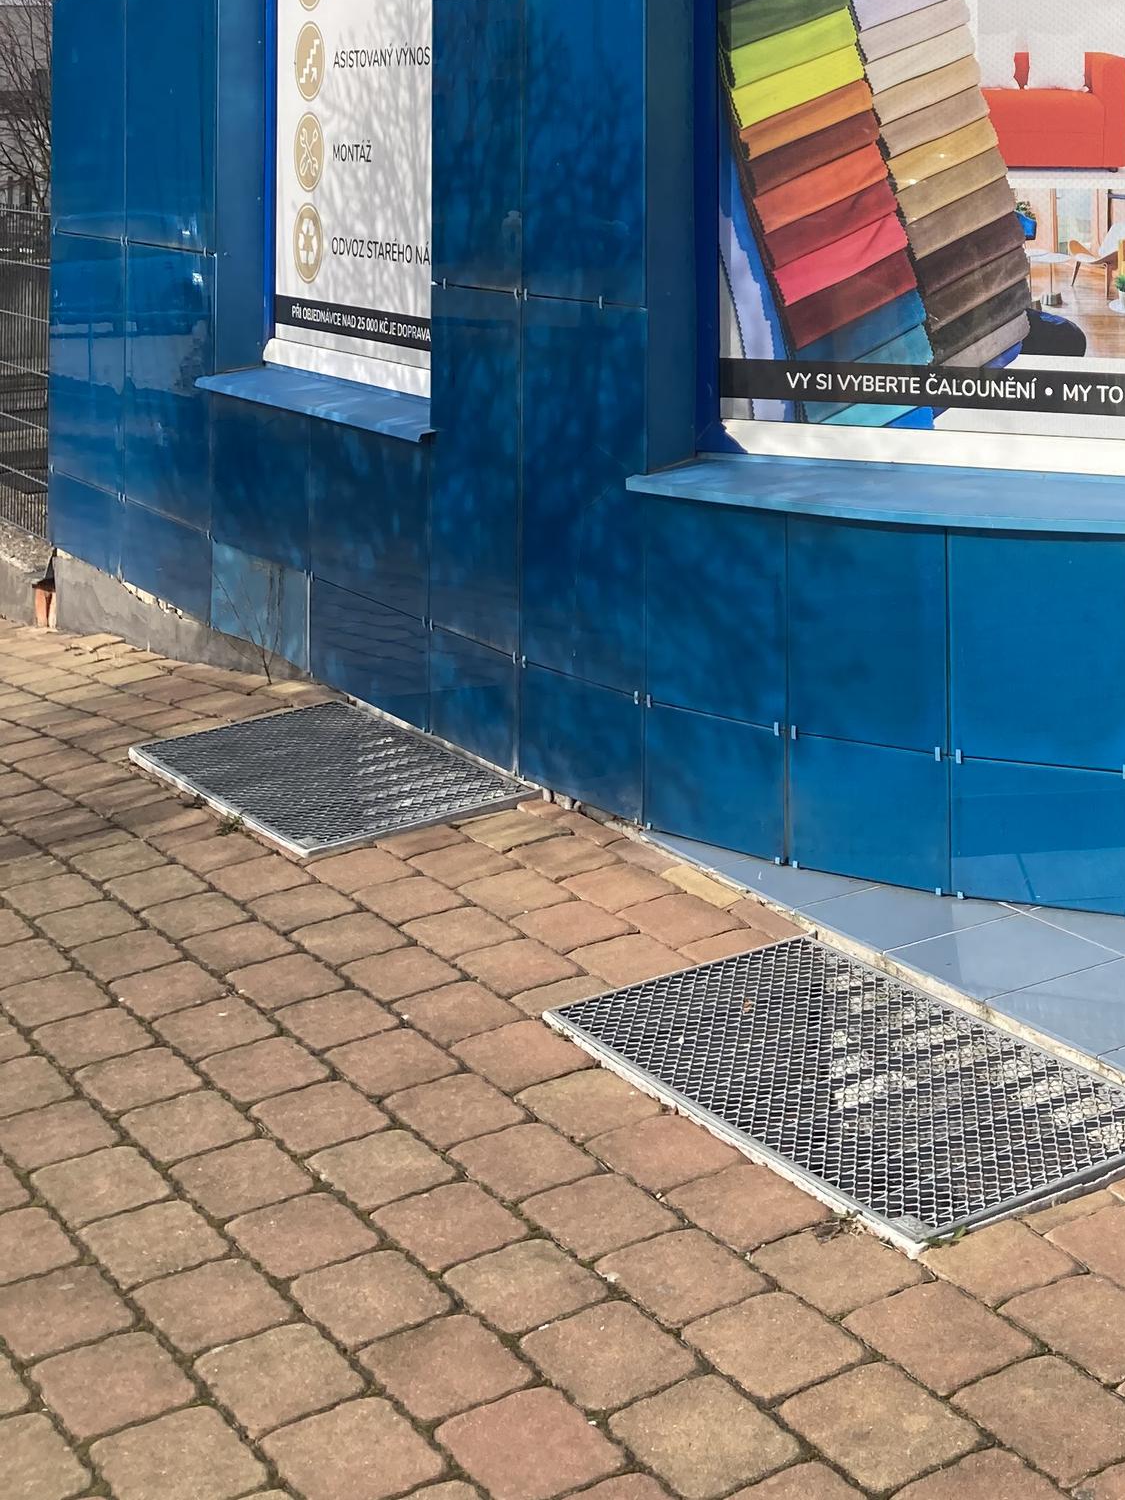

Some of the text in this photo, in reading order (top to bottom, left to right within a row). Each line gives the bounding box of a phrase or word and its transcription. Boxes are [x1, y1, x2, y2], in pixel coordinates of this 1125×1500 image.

[333, 42, 431, 68] ASISTOVANÝ VÝNOS
[332, 140, 372, 163] MONTÁŽ
[331, 237, 365, 258] ODVOZ
[367, 238, 413, 264] STARÉHO
[302, 307, 342, 326] OBJEDNÁVCE
[342, 314, 357, 328] NAD
[389, 322, 396, 336] JE
[397, 324, 431, 341] DOPRAVA
[786, 372, 812, 389] VY
[815, 373, 832, 390] SI
[837, 374, 921, 394] VYBERTE
[925, 373, 1039, 399] ČALOUNĚNÍ
[1063, 383, 1092, 402] MY
[1096, 385, 1124, 404] TO
